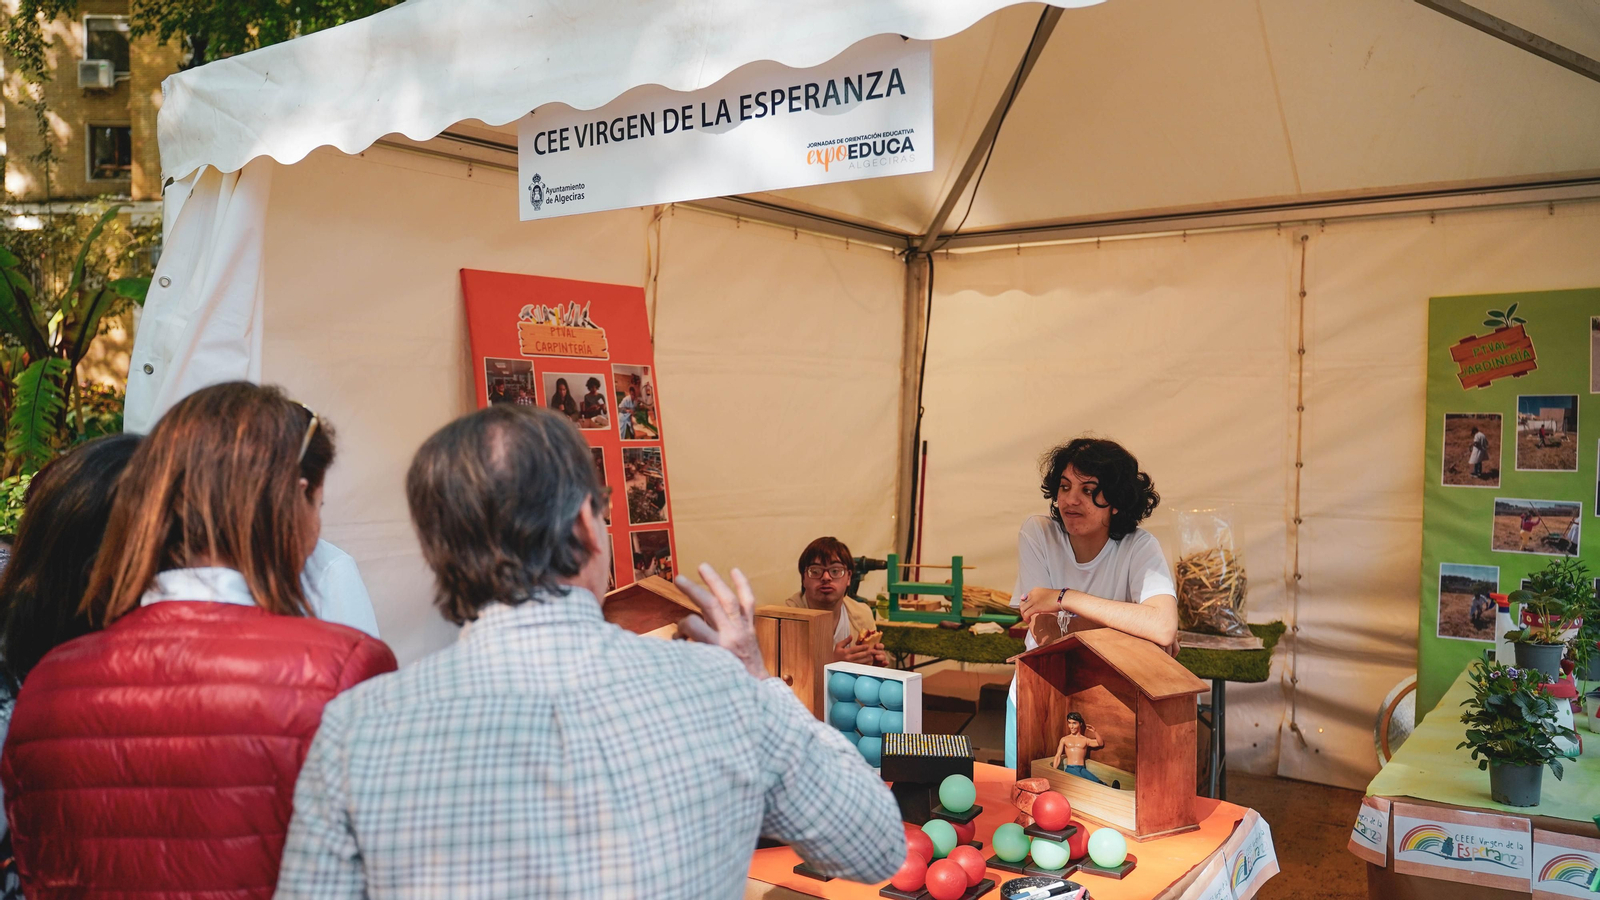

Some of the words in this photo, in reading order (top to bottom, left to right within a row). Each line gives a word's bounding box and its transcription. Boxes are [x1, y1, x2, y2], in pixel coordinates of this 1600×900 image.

[533, 126, 570, 157] CEE
[574, 111, 656, 149] VIRGEN
[663, 104, 694, 134] DE
[701, 98, 732, 129] LA
[739, 67, 907, 121] ESPERANZA
[807, 140, 836, 149] JORNADAS
[844, 132, 882, 143] ORIENTACIÓN
[883, 128, 915, 137] EDUCATIVA
[848, 154, 916, 170] ALGECIRAS
[546, 183, 585, 195] Ayuntamiento
[554, 192, 585, 204] Algeciras
[535, 340, 592, 354] CARPINTERÍA
[1461, 349, 1531, 377] JARDINERÍA
[1455, 834, 1475, 845] CEEE
[1506, 840, 1514, 850] de
[1517, 841, 1524, 851] la
[1457, 843, 1525, 867] Esperanza
